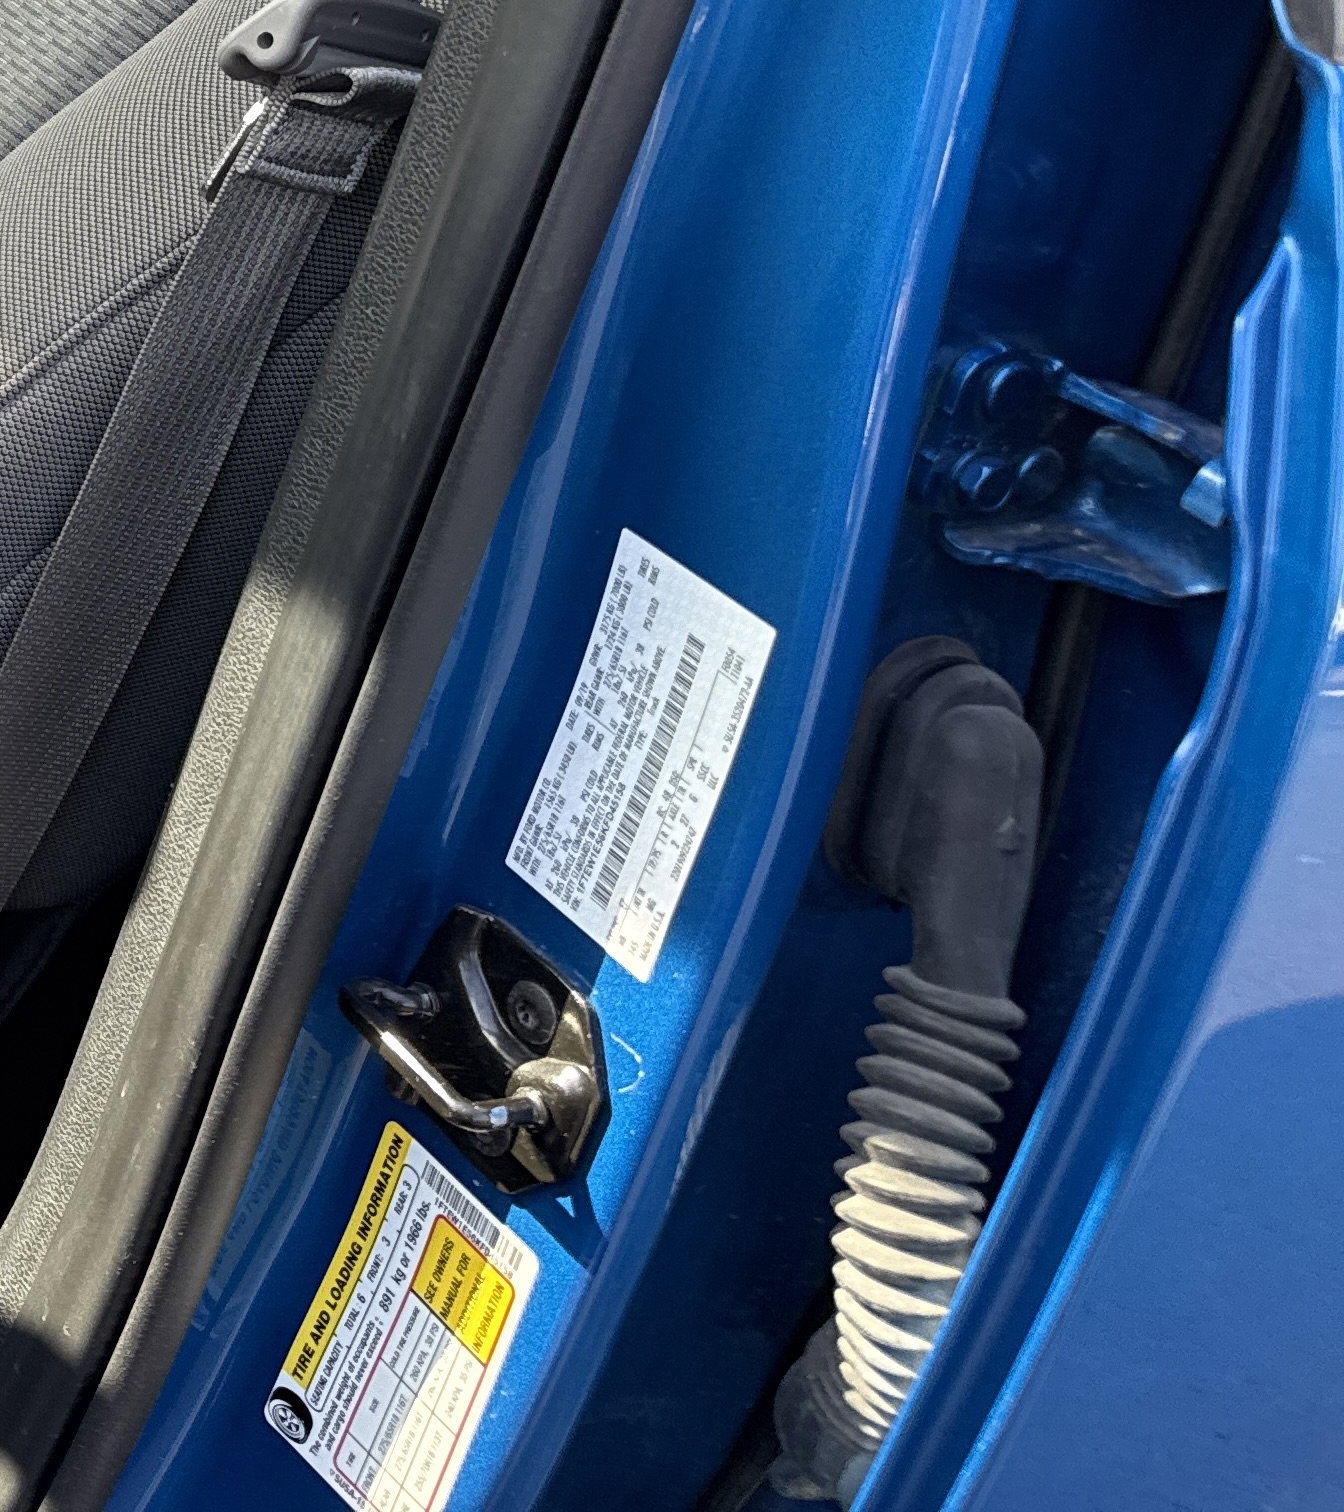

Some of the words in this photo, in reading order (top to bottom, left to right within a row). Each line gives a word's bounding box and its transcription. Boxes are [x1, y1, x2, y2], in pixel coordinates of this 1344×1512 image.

[522, 812, 536, 835] FORD
[531, 787, 546, 816] MOTOR
[558, 851, 575, 883] VEHICLE
[401, 1178, 412, 1191] 3
[415, 1196, 432, 1222] lbs.
[380, 1234, 391, 1247] 3
[402, 1217, 423, 1253] 1966
[291, 1341, 315, 1384] TIRE
[308, 1307, 331, 1346] AND
[325, 1238, 363, 1312] LOADING
[351, 1131, 408, 1242] INFORMATION
[399, 1252, 411, 1269] or
[428, 1234, 456, 1284] OWNERS
[390, 1264, 406, 1287] kg
[422, 1279, 438, 1304] SEE
[438, 1274, 463, 1321] MANUAL
[454, 1251, 472, 1278] FOR
[355, 1291, 366, 1304] 6
[377, 1285, 395, 1314] 891
[468, 1280, 507, 1353] INFORMATION
[308, 1437, 321, 1457] The
[315, 1398, 339, 1441] combined
[333, 1370, 351, 1403] weight
[345, 1360, 355, 1373] of
[350, 1317, 376, 1365] occupants
[309, 1373, 328, 1406] SEATING
[322, 1338, 344, 1378] CAPACITY
[323, 1432, 335, 1452] and
[331, 1409, 347, 1436] cargo
[341, 1380, 358, 1411] should
[354, 1357, 369, 1383] never
